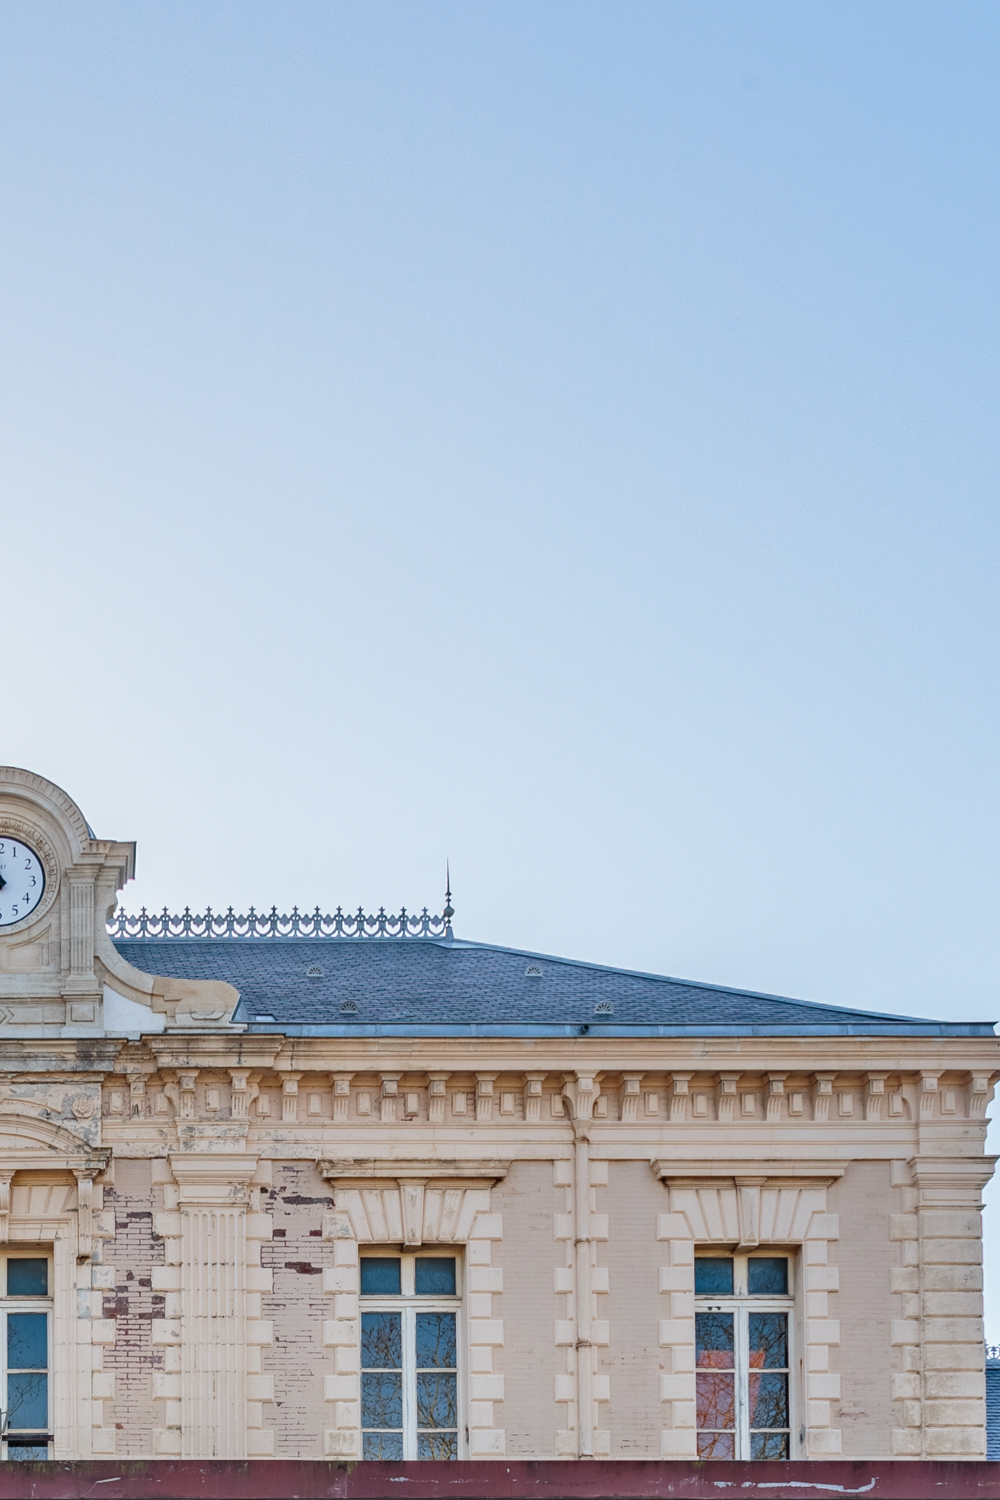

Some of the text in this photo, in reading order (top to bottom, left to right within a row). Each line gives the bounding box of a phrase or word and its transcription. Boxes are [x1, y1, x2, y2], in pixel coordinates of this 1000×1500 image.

[12, 847, 17, 857] 1
[24, 859, 32, 870] 2
[29, 876, 36, 887] 3
[22, 892, 30, 904] 4
[11, 905, 18, 916] 5
